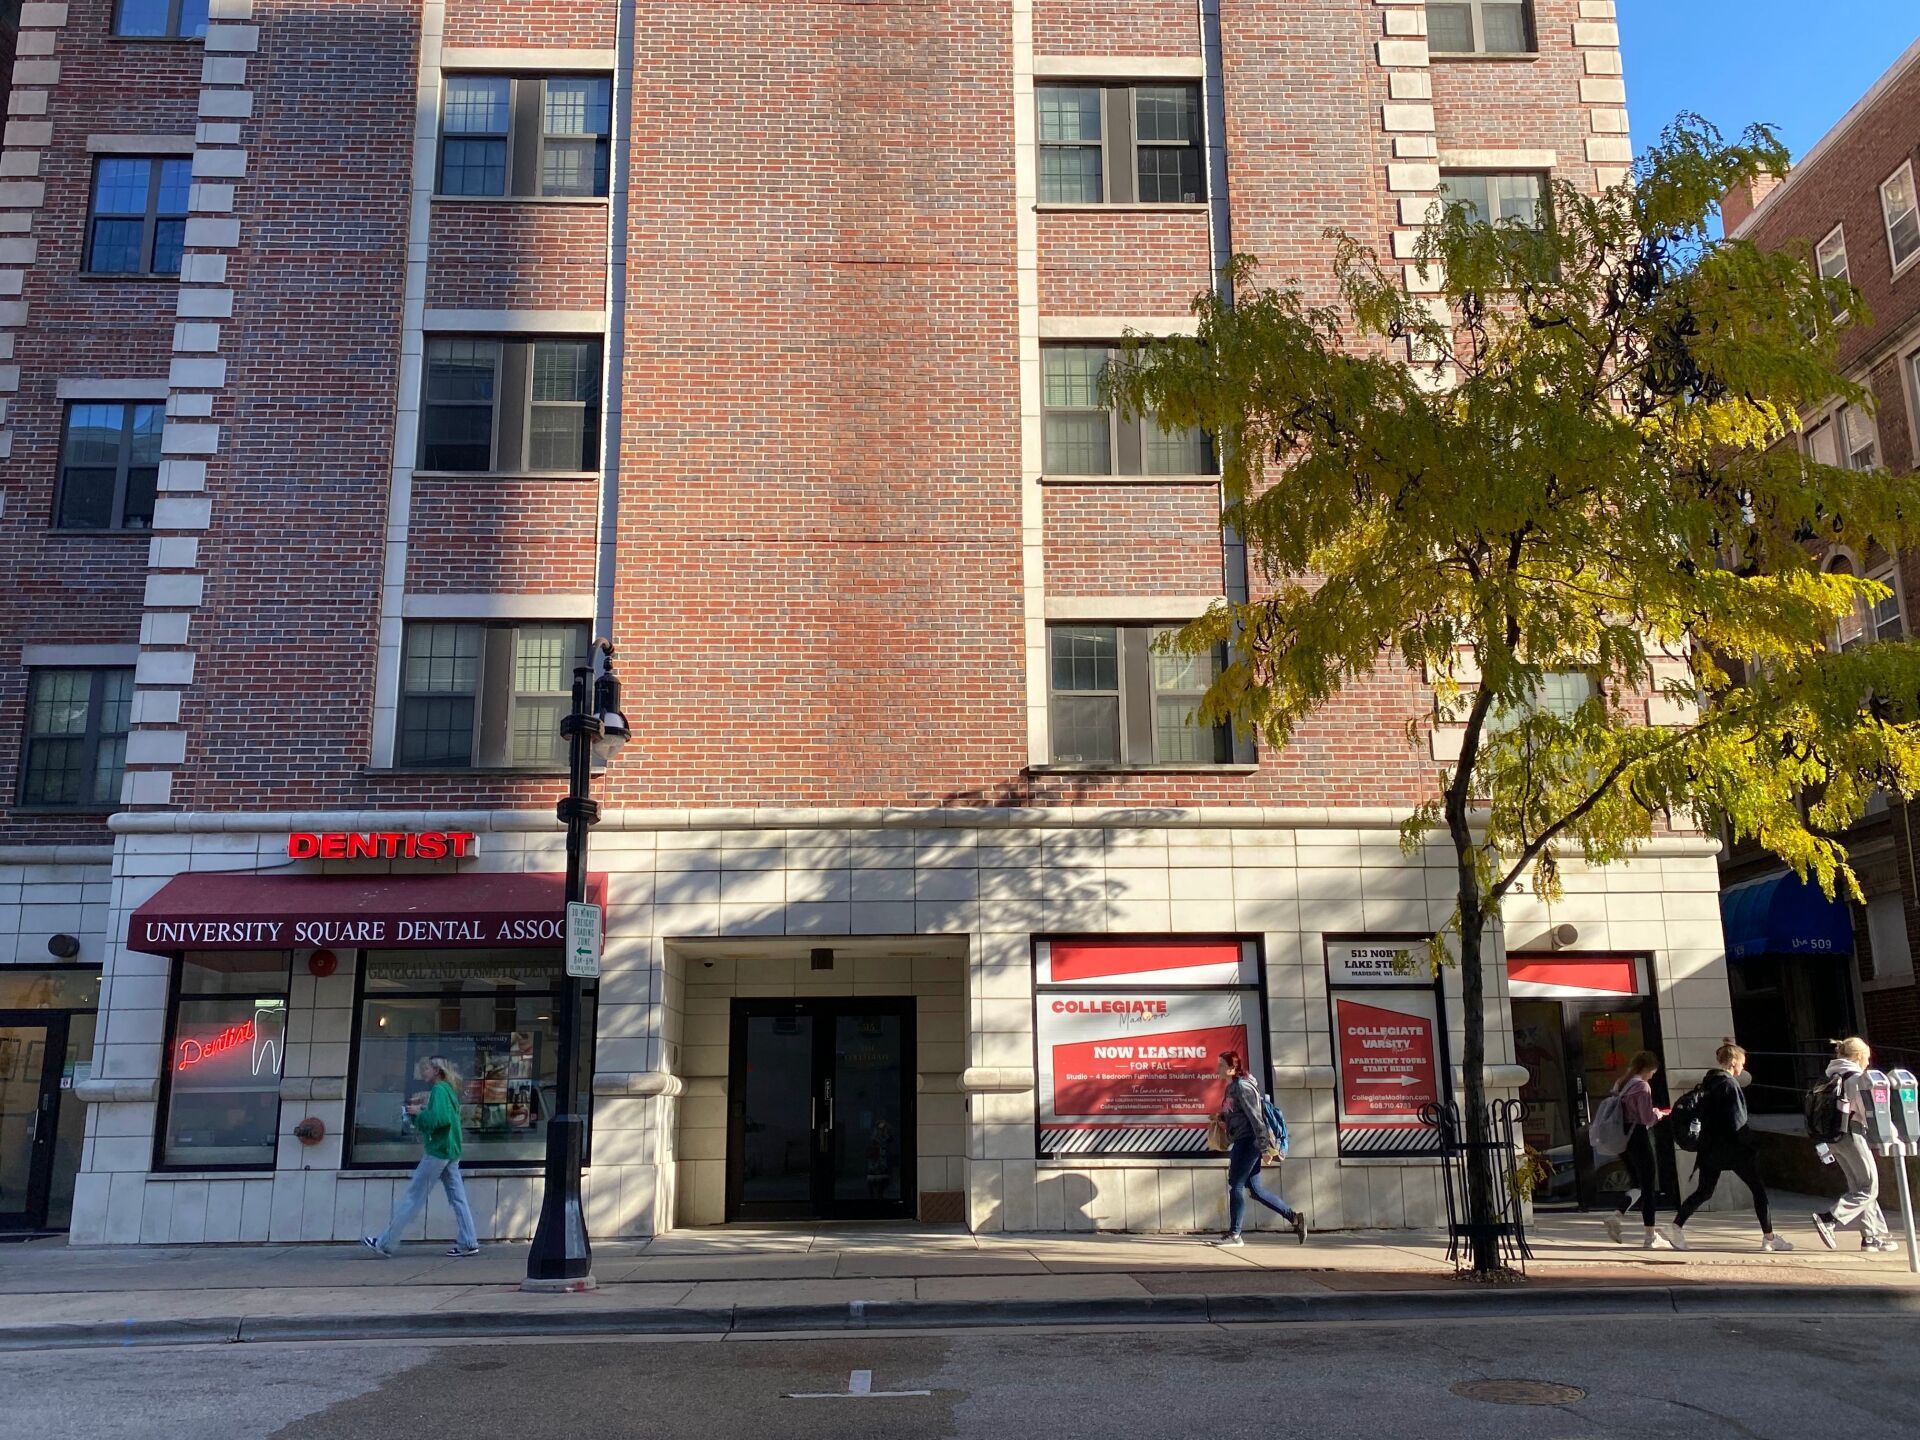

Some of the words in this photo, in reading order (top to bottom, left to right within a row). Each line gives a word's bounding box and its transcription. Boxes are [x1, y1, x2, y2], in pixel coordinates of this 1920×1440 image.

[287, 832, 474, 859] DENTIST
[581, 909, 598, 919] MINUTE
[574, 918, 595, 928] FREIGHT
[145, 922, 284, 943] UNIVERSITY
[294, 921, 385, 946] SQUARE
[396, 920, 486, 941] DENTAL
[574, 927, 595, 938] LOADING
[577, 937, 591, 947] ZONE
[1810, 939, 1832, 950] 509
[1351, 949, 1368, 958] 513
[1344, 960, 1373, 969] LAKE
[368, 962, 426, 980] GENERAL
[431, 962, 457, 979] AND
[1051, 1000, 1167, 1013] COLLEGIATE
[1119, 1012, 1170, 1031] Madison
[1348, 1027, 1424, 1035] COLLEGIATE
[178, 1019, 255, 1071] Dentist
[1362, 1039, 1411, 1049] VARSITY
[1093, 1046, 1134, 1059] NOW
[1137, 1046, 1207, 1059] LEASING
[1129, 1061, 1149, 1070] FOR
[1151, 1061, 1172, 1070] FALL
[1349, 1057, 1399, 1065] APARTMENT
